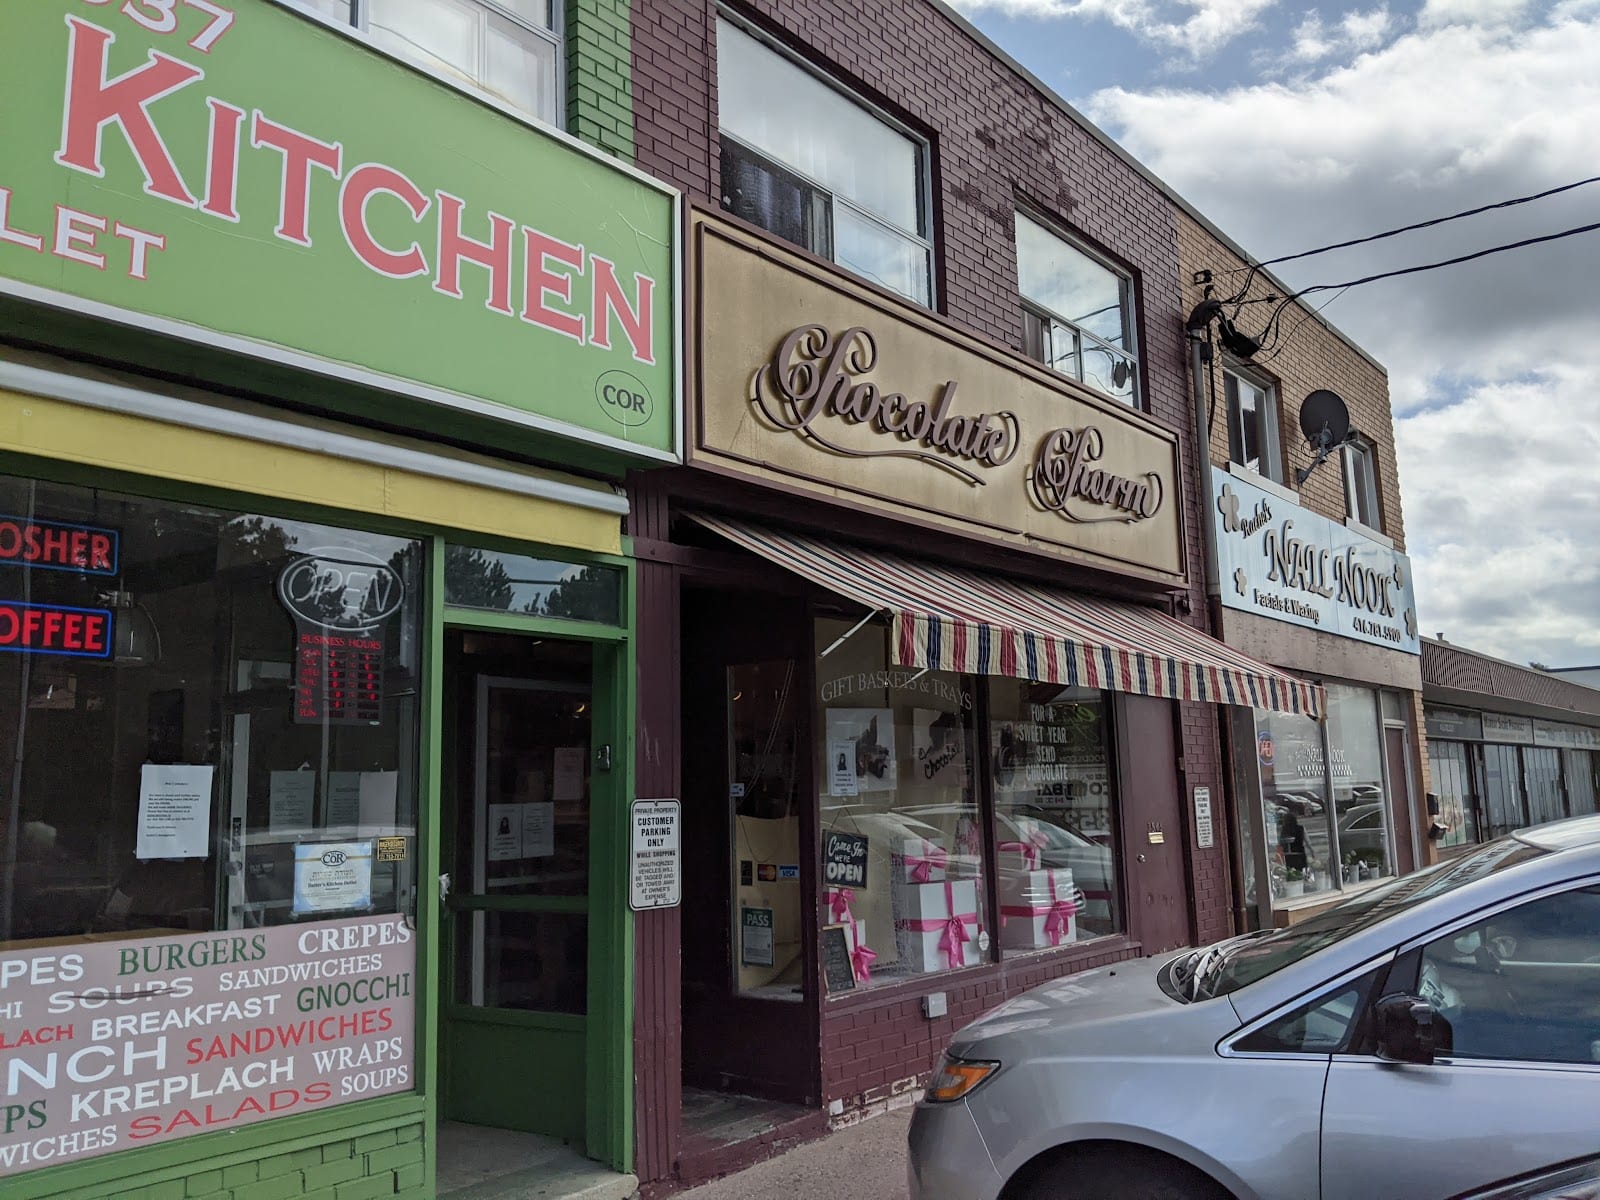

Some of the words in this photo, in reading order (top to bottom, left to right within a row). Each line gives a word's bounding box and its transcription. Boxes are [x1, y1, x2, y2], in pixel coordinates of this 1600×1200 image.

[81, 0, 235, 54] 37
[53, 13, 655, 366] KITCHEN
[0, 187, 165, 281] LET
[601, 383, 646, 415] COR
[751, 324, 1020, 487] Chocolate
[1026, 424, 1164, 524] Charm
[0, 521, 112, 571] OSHER
[1264, 519, 1334, 600] NAIL
[1334, 546, 1396, 618] NOOK
[288, 564, 393, 614] OPEN
[1254, 588, 1284, 612] Facials
[1291, 599, 1320, 625] Waxing
[0, 606, 104, 650] OFFEE
[820, 674, 855, 702] GIFT
[857, 670, 918, 692] BASKETS
[919, 679, 930, 693] &
[932, 678, 973, 711] TRAYS
[1031, 704, 1045, 722] FOR
[1048, 706, 1054, 722] A
[1019, 724, 1044, 743] SWEET
[1047, 726, 1067, 743] YEAR
[1025, 764, 1069, 781] CHOCOLATE
[1036, 745, 1056, 762] SEND
[637, 816, 674, 826] CUSTOMER
[641, 827, 671, 837] PARKING
[647, 839, 664, 847] ONLY
[828, 835, 852, 857] Come
[851, 841, 865, 857] In
[826, 864, 863, 882] OPEN
[298, 920, 411, 955] CREPES
[746, 913, 769, 927] PASS
[0, 954, 84, 990] PES
[117, 933, 267, 976] BURGERS
[218, 953, 384, 992] SANDWICHES
[47, 976, 195, 1014] SOUPS
[296, 973, 411, 1012] GNOCCHI
[91, 994, 281, 1041] BREAKFAST
[186, 1007, 393, 1065] SANDWICHES
[7, 1036, 168, 1096] NCH
[312, 1036, 403, 1075] WRAPS
[70, 1056, 295, 1123] KREPLACH
[340, 1064, 410, 1097] SOUPS
[128, 1082, 333, 1140] SALADS
